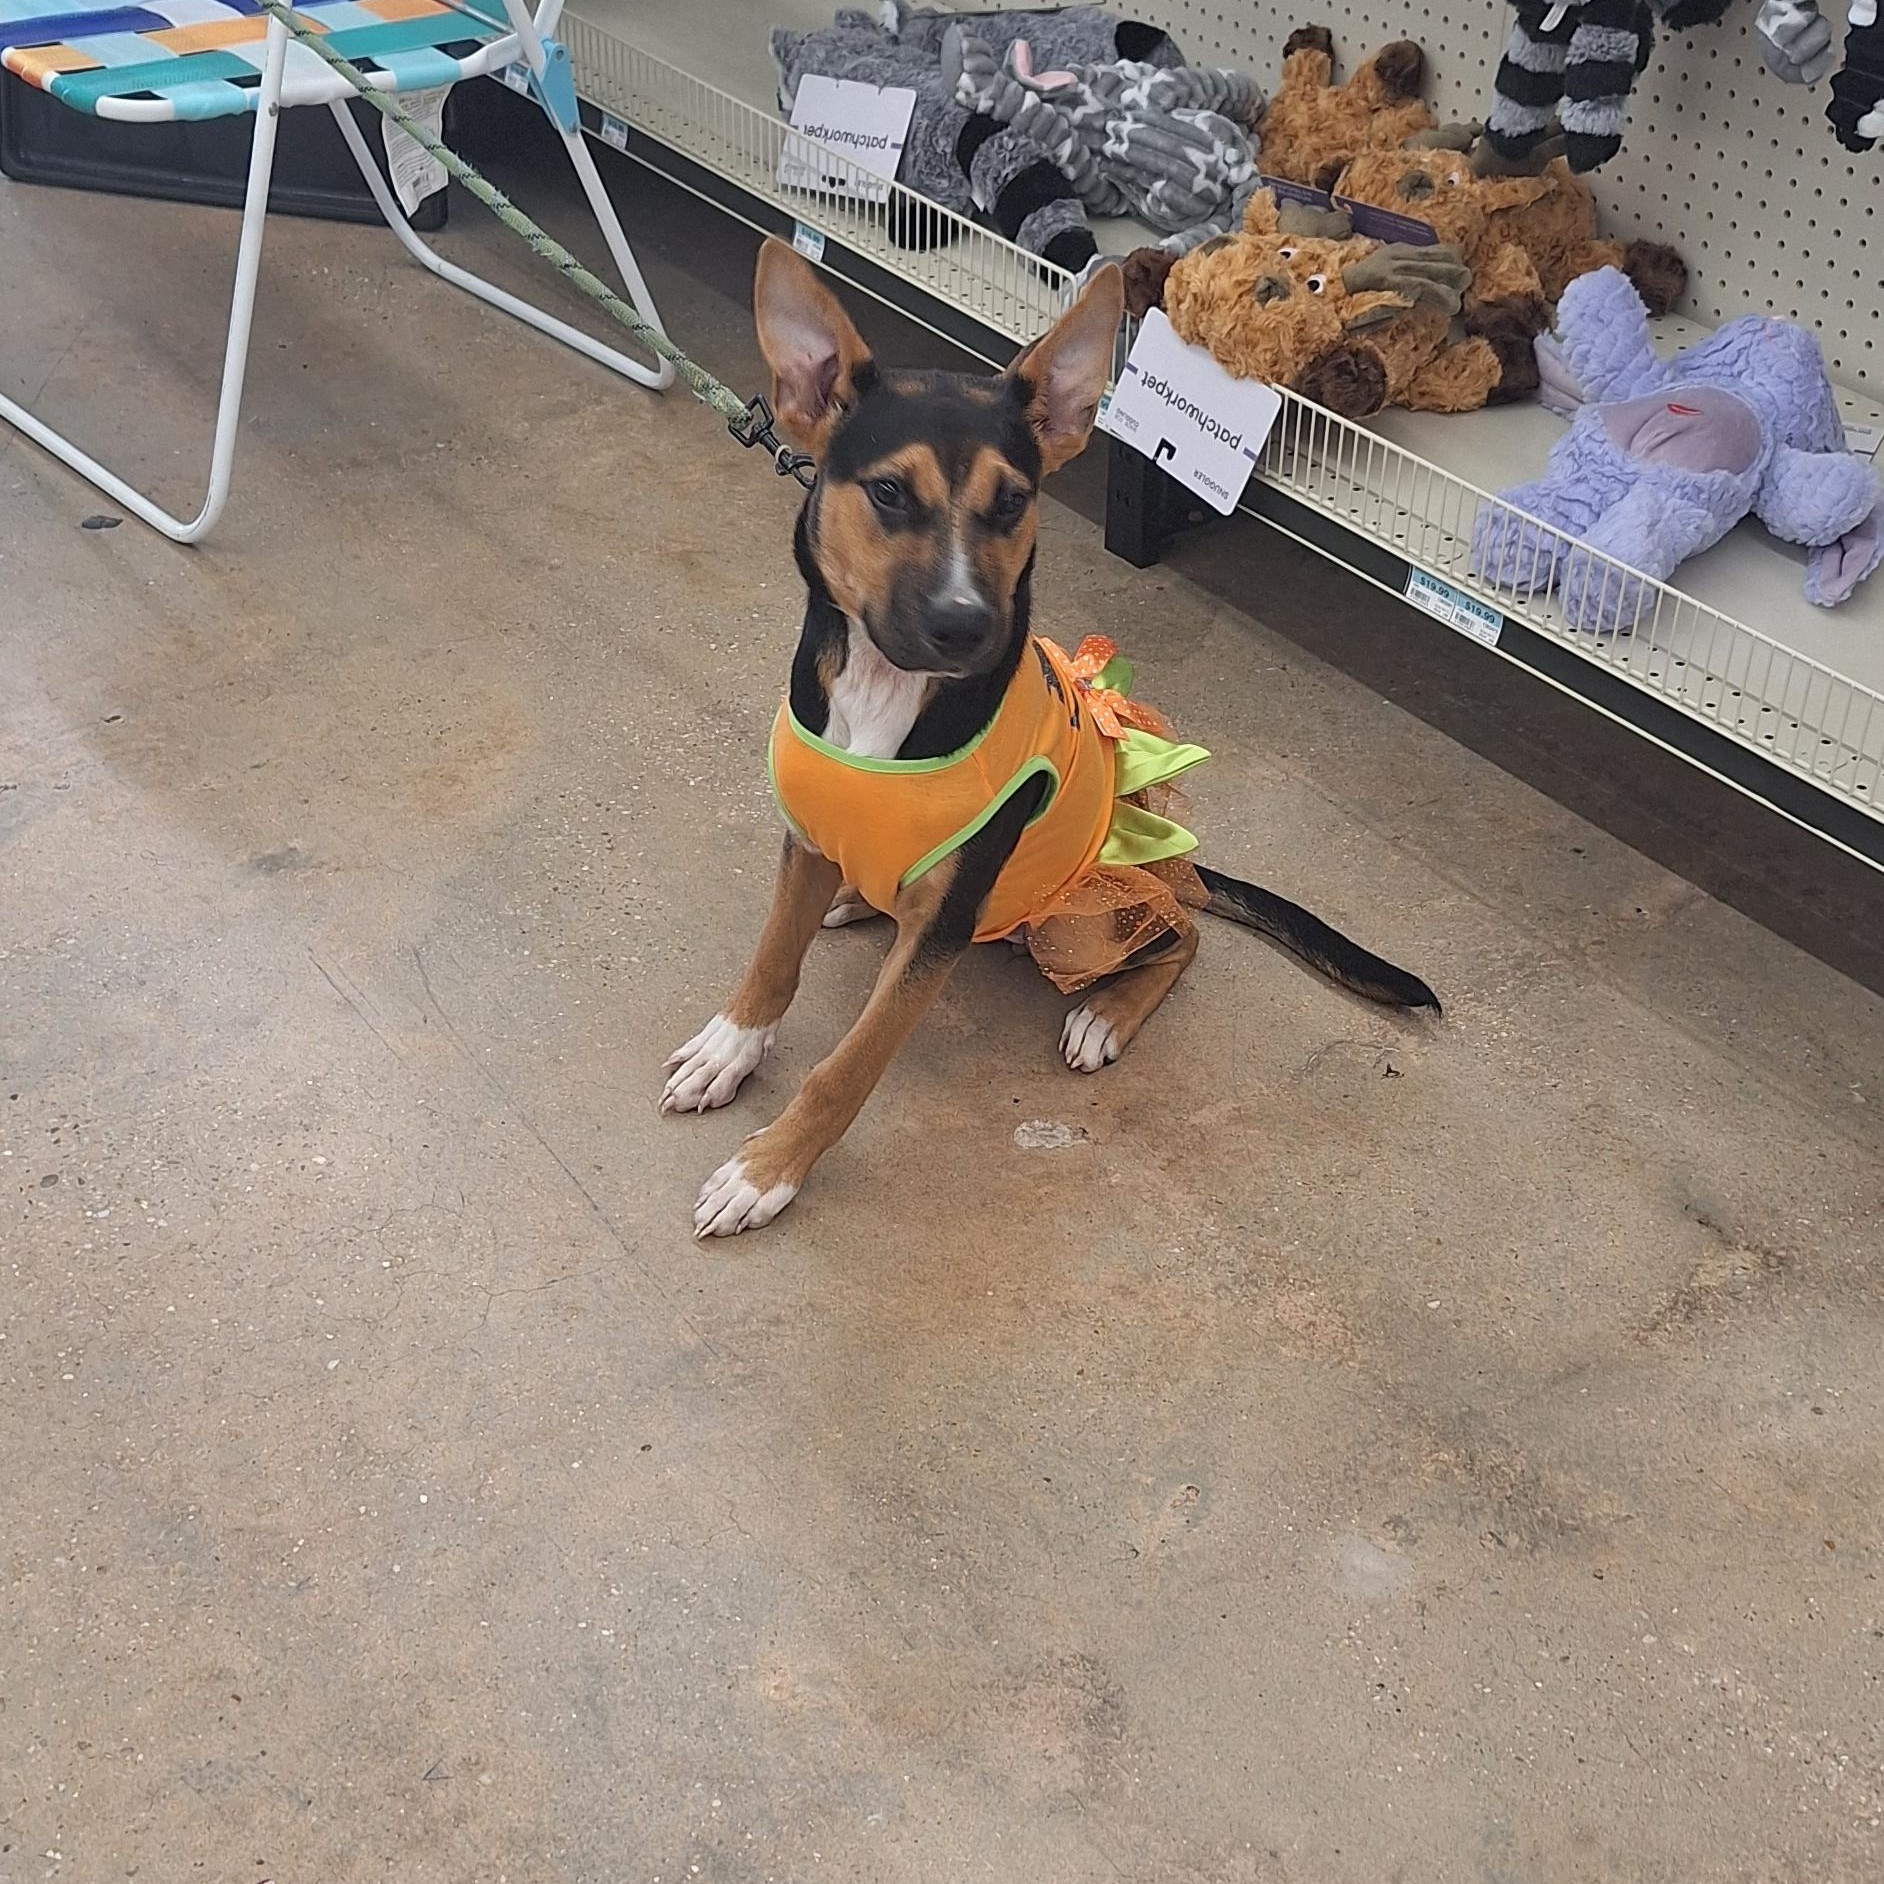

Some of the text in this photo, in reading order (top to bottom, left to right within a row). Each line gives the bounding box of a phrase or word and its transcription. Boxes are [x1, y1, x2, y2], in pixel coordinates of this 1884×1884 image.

[1140, 371, 1243, 451] patchworkpet
[1193, 468, 1230, 501] SNUGGLER
[1420, 576, 1450, 599] $19.99
[1465, 601, 1495, 624] $19.99
